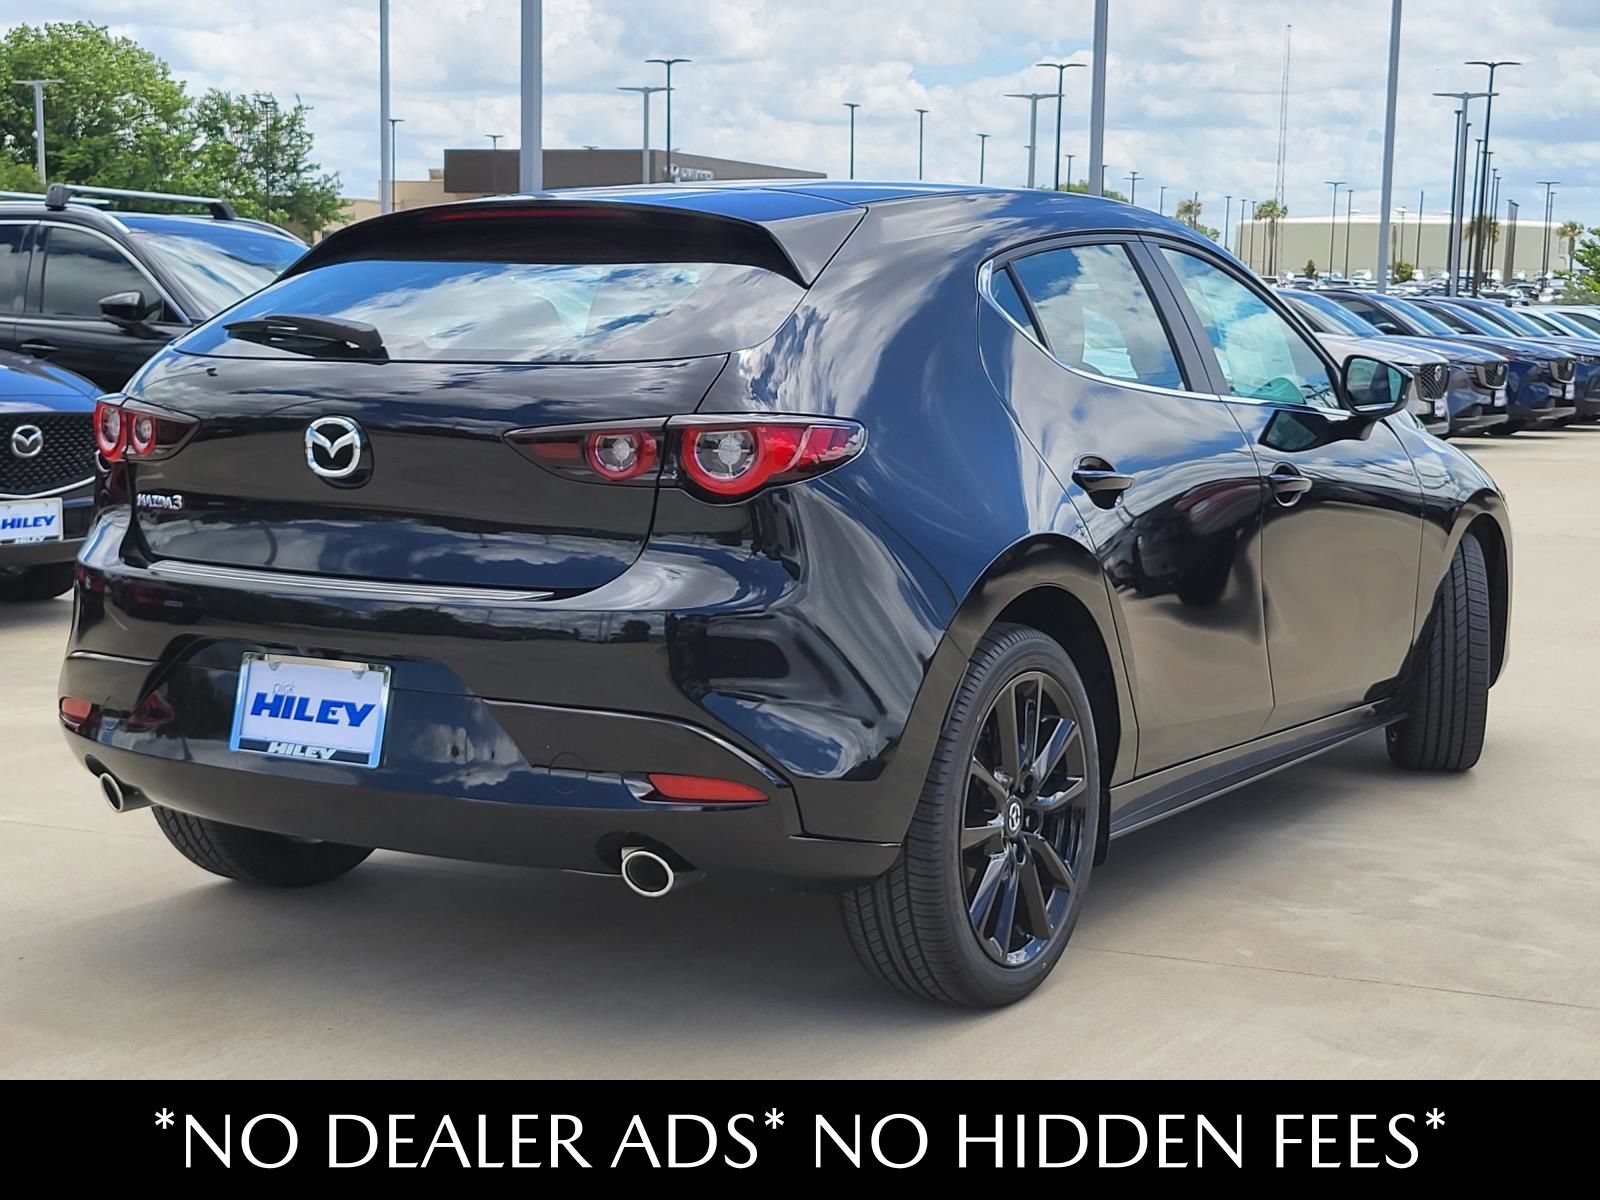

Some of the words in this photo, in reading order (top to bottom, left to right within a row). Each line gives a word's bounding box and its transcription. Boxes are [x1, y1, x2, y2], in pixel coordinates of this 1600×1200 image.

[1, 514, 56, 530] HILEY
[250, 692, 376, 727] HILEY
[267, 741, 337, 760] HILEY
